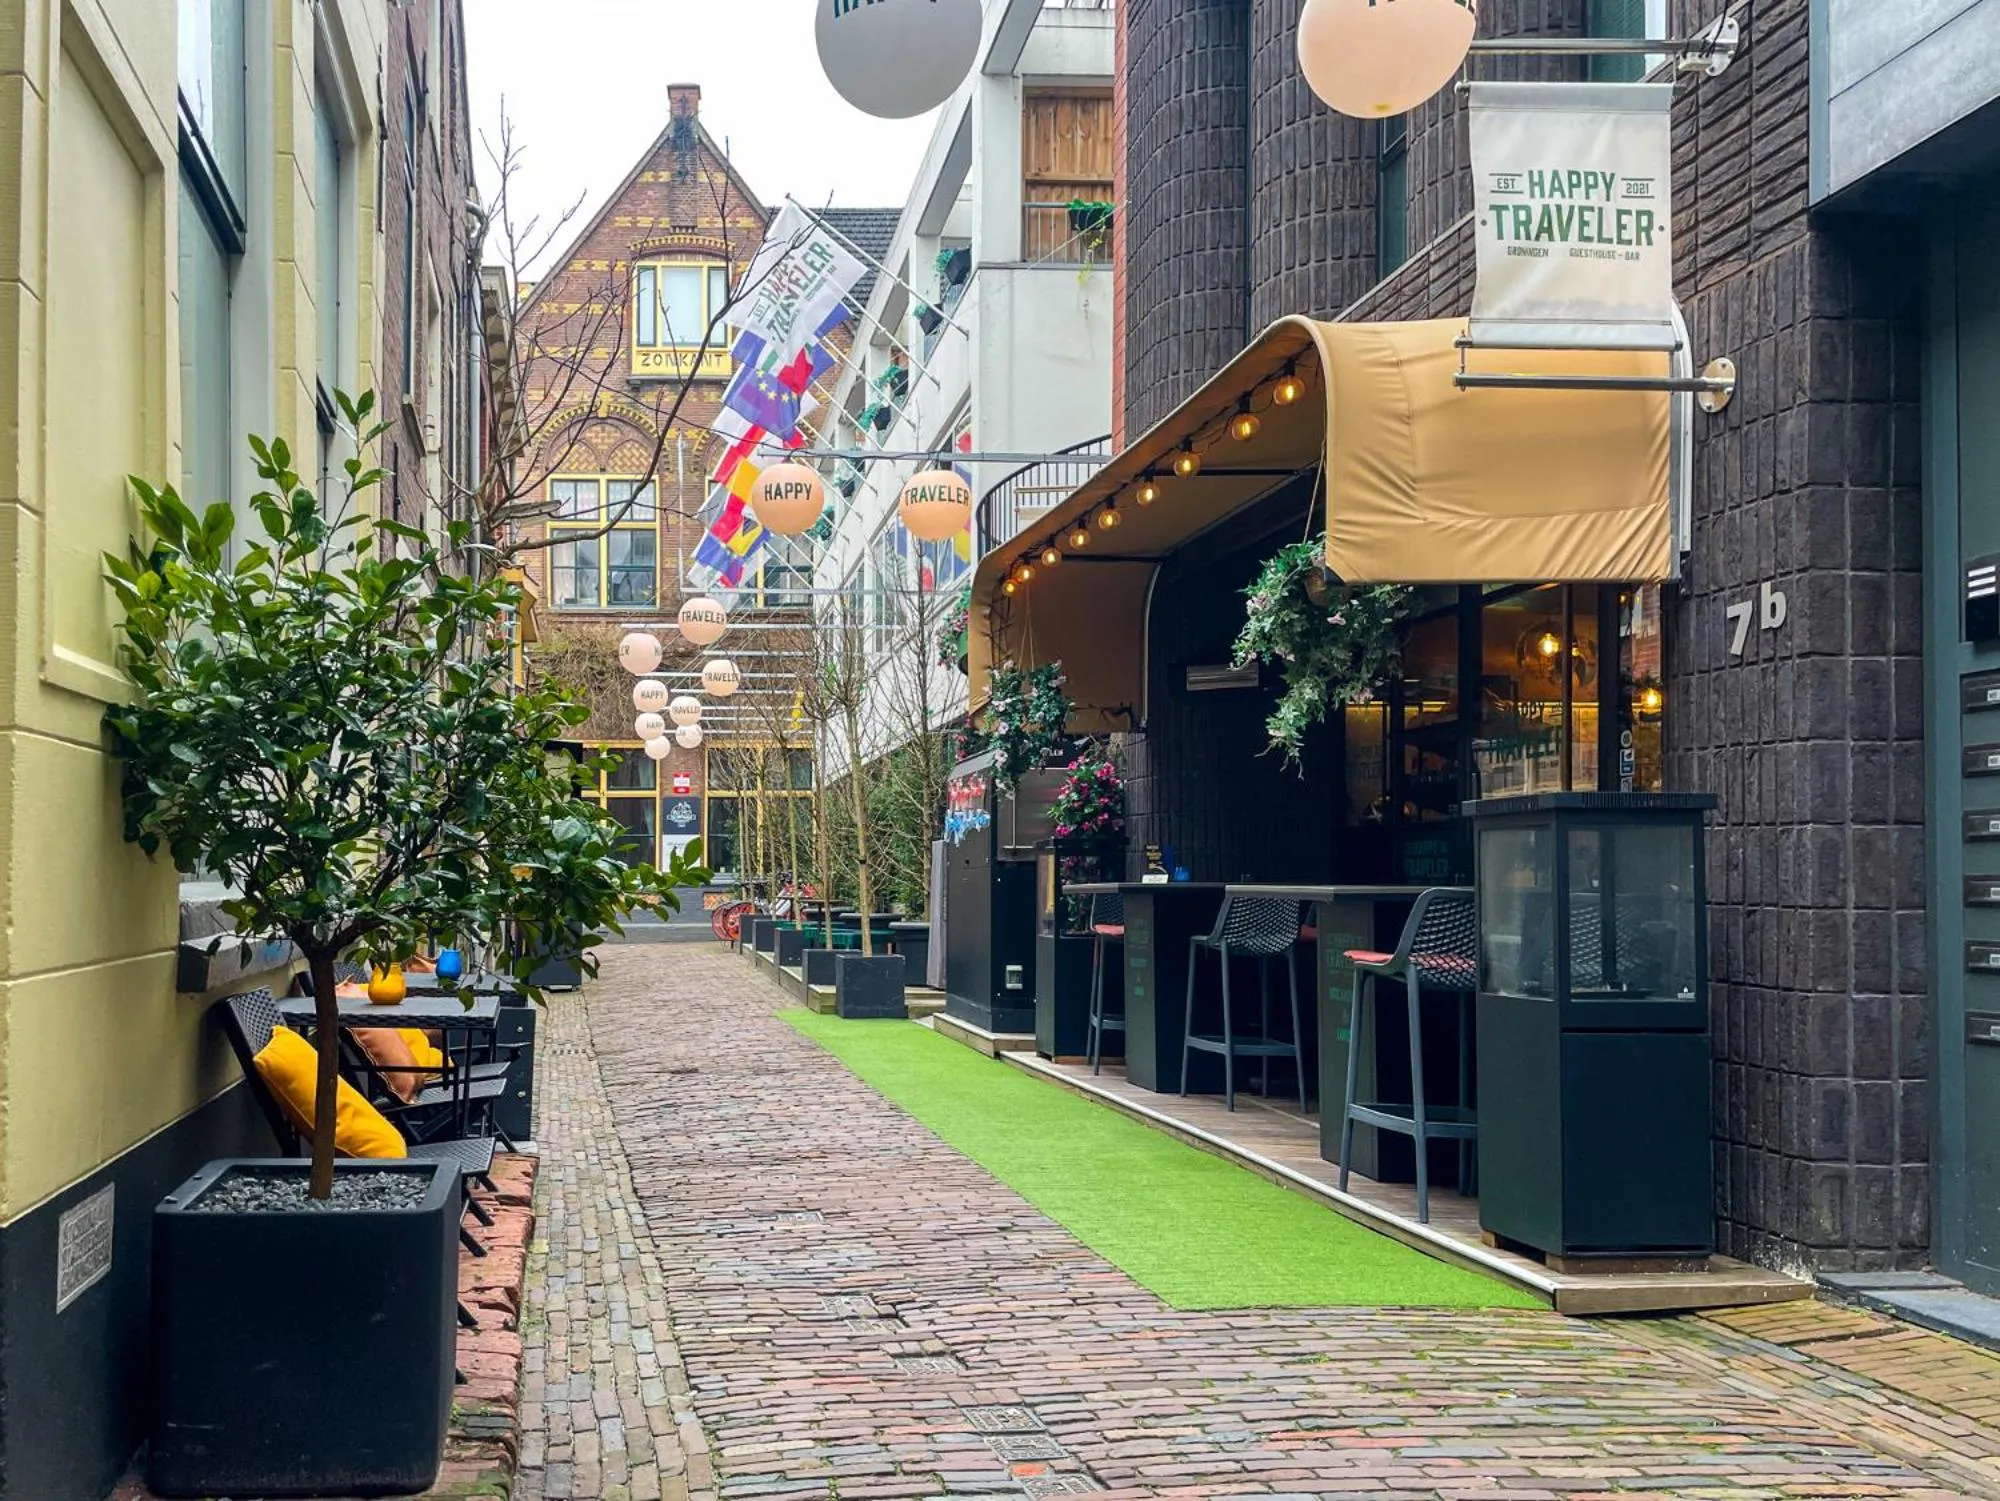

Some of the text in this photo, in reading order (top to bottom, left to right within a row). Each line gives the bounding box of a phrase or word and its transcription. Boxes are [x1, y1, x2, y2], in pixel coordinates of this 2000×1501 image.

[1496, 170, 1649, 202] EST HAPPY 2021
[1489, 203, 1654, 246] TRAVELER
[766, 241, 834, 343] TRAVELER
[641, 353, 723, 368] ZONKANT
[764, 482, 969, 507] HAPPY TRAVELER
